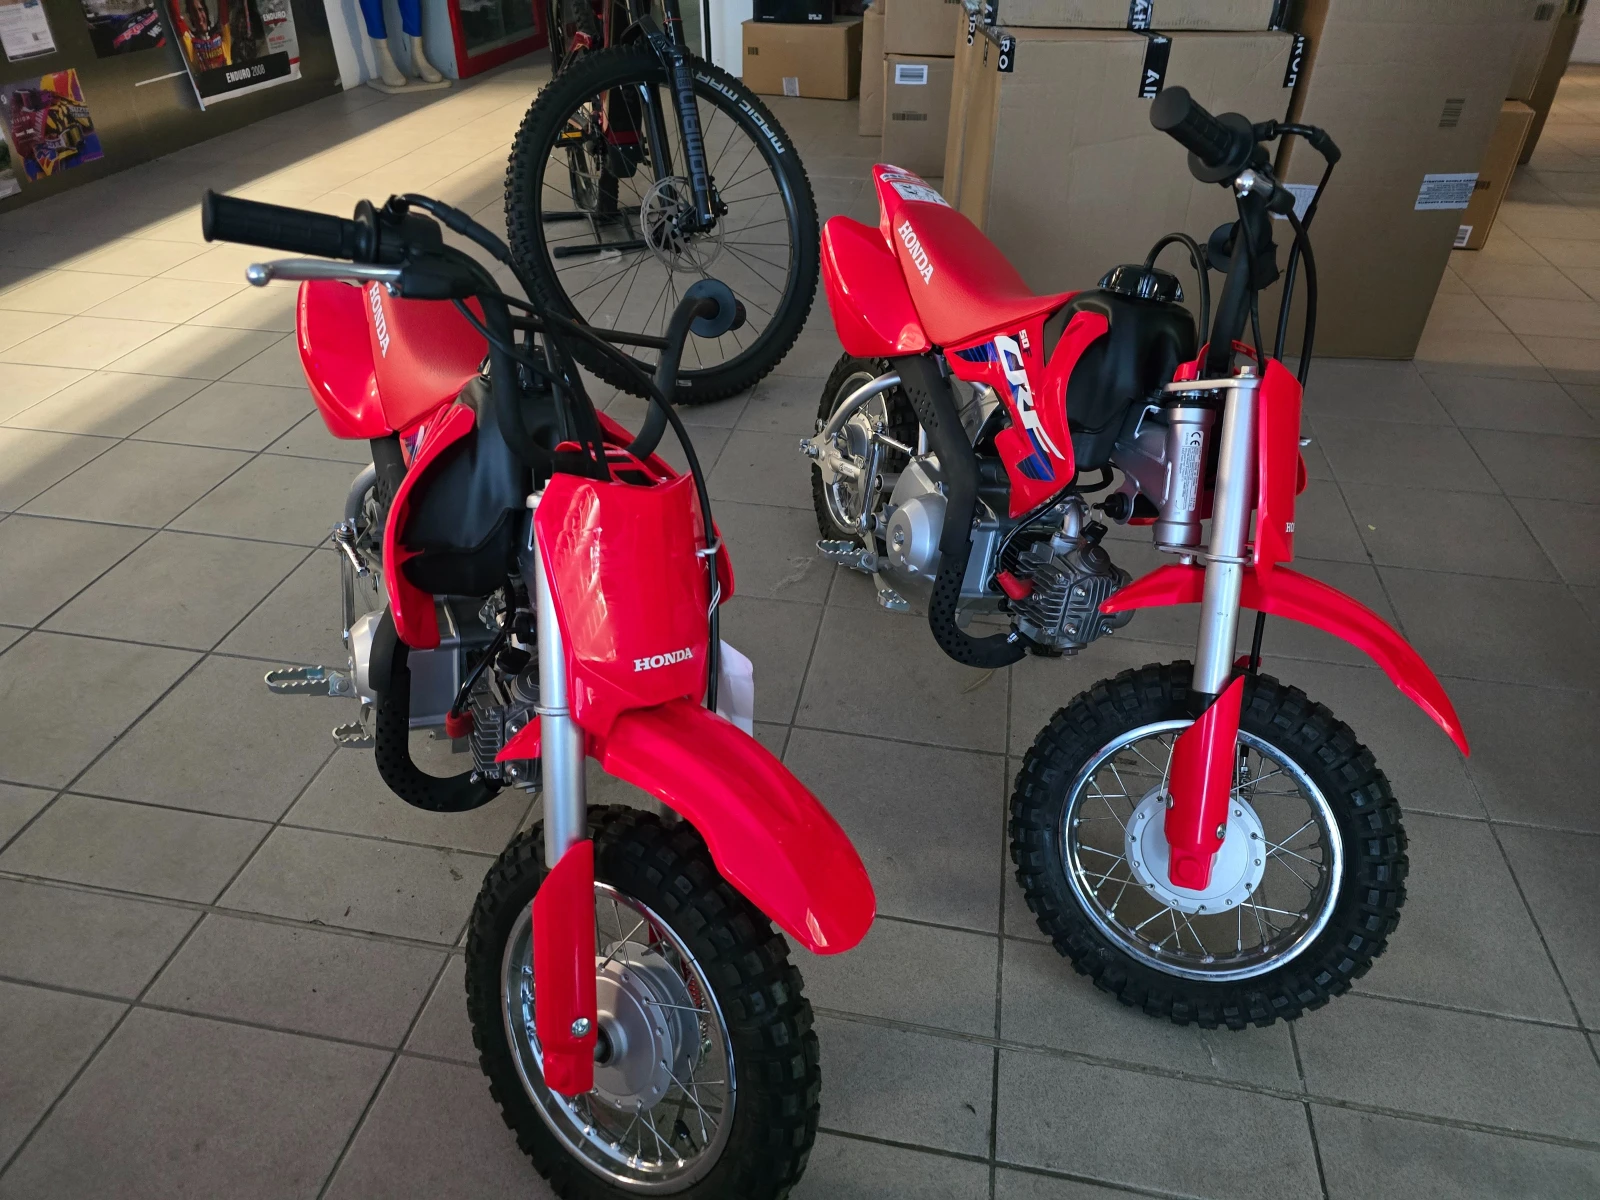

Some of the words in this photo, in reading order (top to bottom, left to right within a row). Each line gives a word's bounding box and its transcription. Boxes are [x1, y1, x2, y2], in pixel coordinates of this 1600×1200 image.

[262, 11, 286, 22] ENDURO
[225, 68, 251, 83] ENDURO
[691, 68, 739, 102] MAR
[738, 99, 786, 154] MAGIC
[898, 220, 934, 285] HONDA
[369, 280, 390, 358] HONDA
[994, 335, 1065, 461] CRF
[633, 647, 693, 673] HONDA
